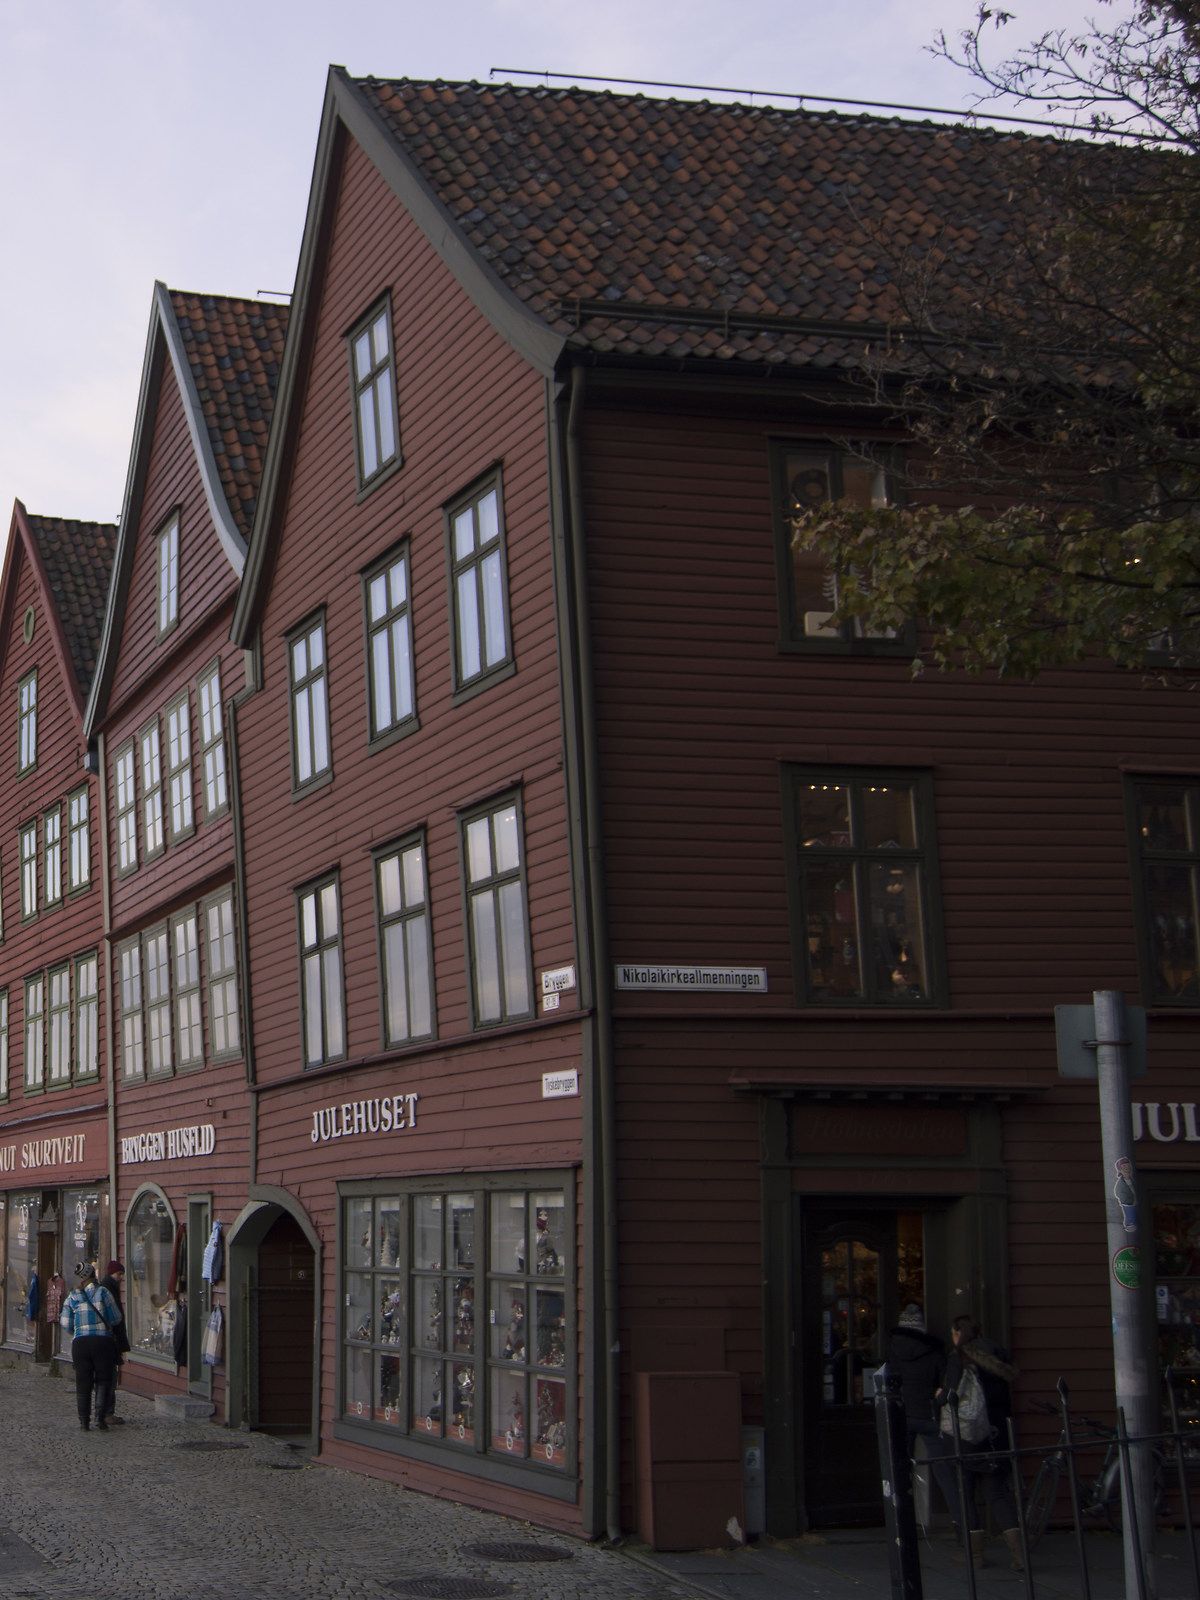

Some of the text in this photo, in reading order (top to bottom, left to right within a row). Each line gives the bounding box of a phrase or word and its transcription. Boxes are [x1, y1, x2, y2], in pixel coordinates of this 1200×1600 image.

[544, 973, 569, 990] Bryggen
[623, 968, 760, 988] Nikolaikirkeallmenningen
[544, 1076, 575, 1094] Tyskebryggen
[310, 1092, 418, 1143] JULEHUSET
[21, 1133, 86, 1169] SKURTVEIT
[120, 1124, 216, 1165] BRYGGEN HUSFLID
